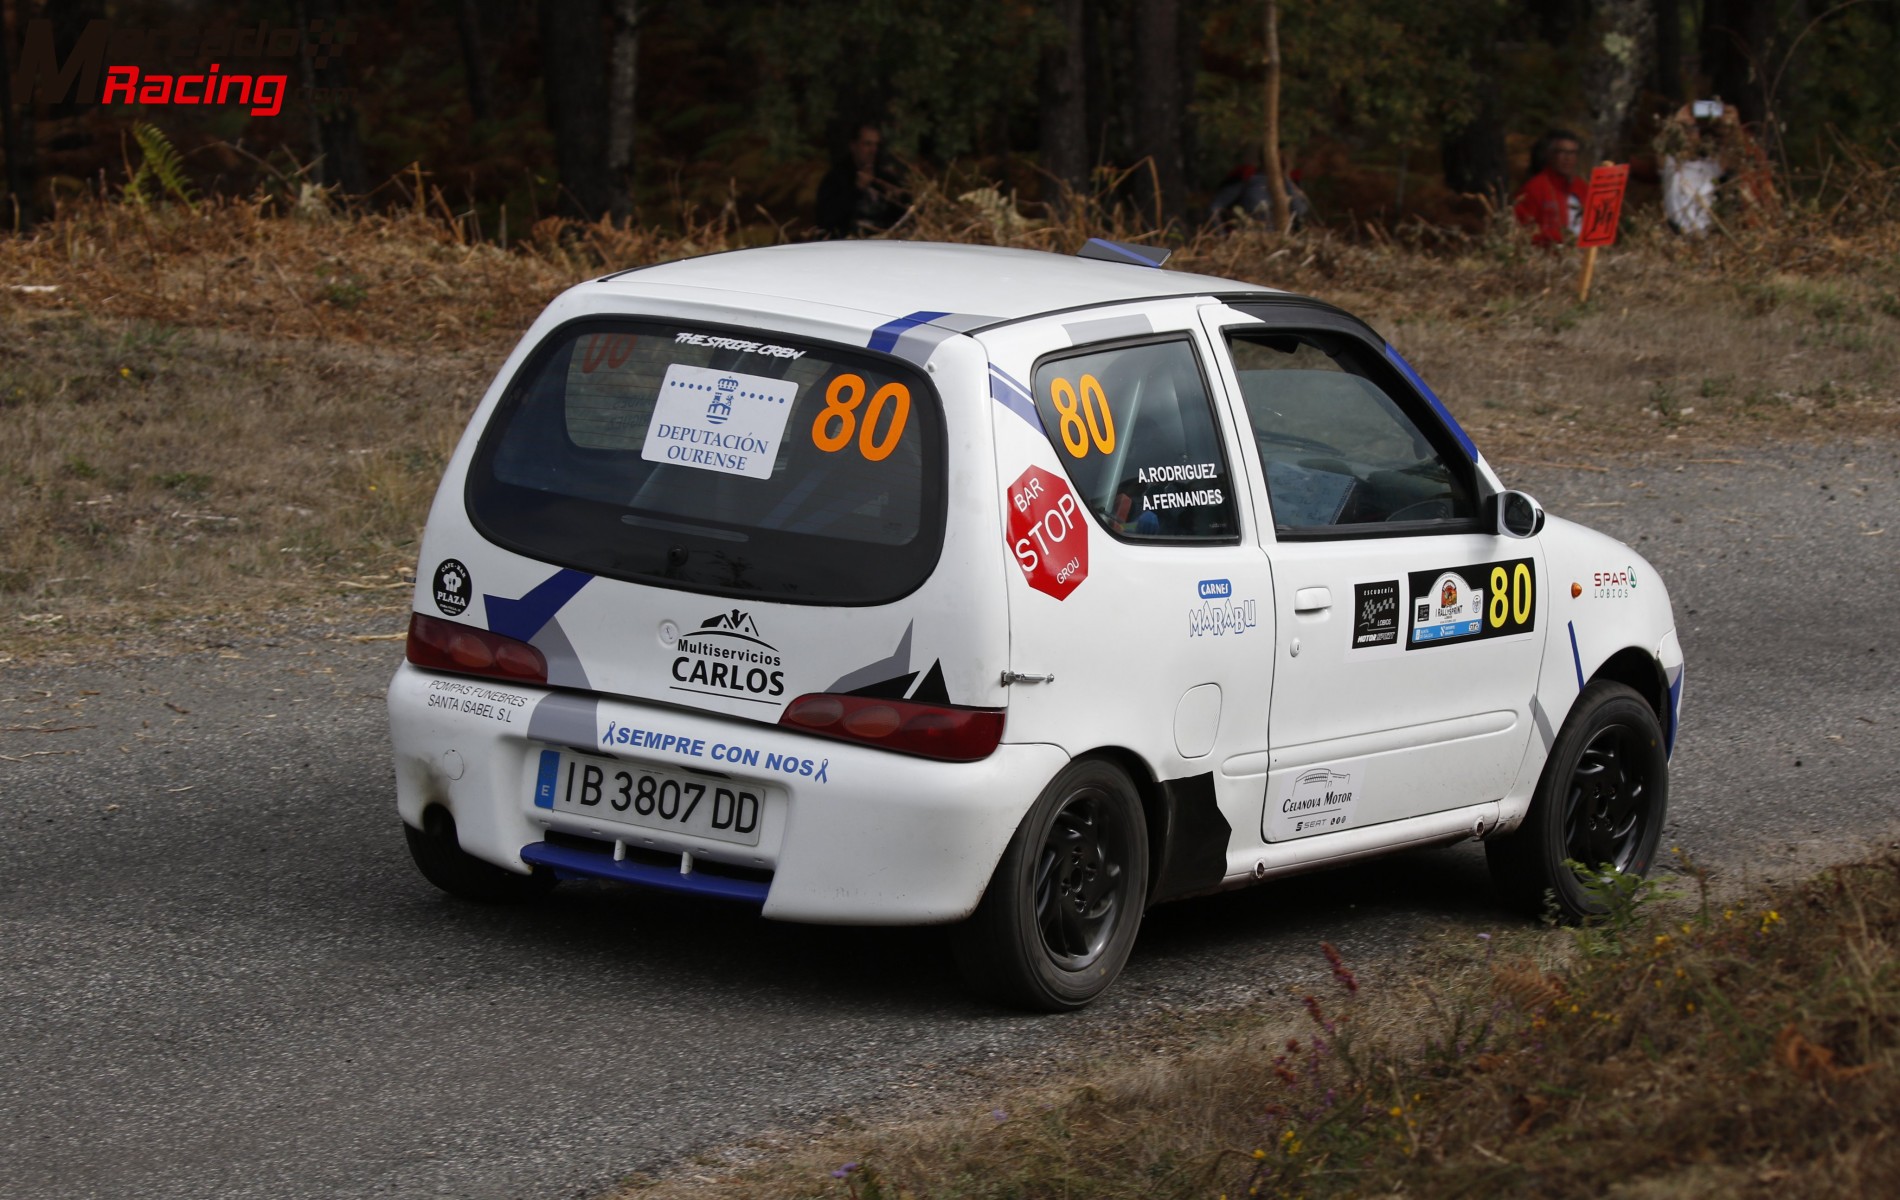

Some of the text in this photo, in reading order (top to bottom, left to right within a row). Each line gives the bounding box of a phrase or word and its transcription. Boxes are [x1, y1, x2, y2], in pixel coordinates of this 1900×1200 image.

[674, 332, 807, 360] THE STRIPE CREW
[811, 373, 912, 462] 80
[1050, 374, 1116, 458] 80
[657, 423, 769, 455] DEPUTACIÓN
[667, 445, 748, 471] OURENSE
[1138, 463, 1217, 483] A.RODRIGUEZ
[1014, 478, 1044, 513] BAR
[1142, 489, 1223, 511] A.FERNANDES
[1015, 494, 1075, 572] STOP
[1056, 557, 1080, 584] GROU
[1594, 572, 1628, 587] SPAR
[437, 591, 467, 607] PLAZA
[1201, 583, 1229, 596] CARNES
[1490, 563, 1532, 628] 80
[1594, 589, 1629, 599] LOBIOS
[1189, 598, 1257, 638] MARABU
[677, 638, 781, 667] Multiservicios
[672, 656, 785, 697] CARLOS
[428, 680, 529, 707] POMPAS FUNEBRES
[428, 694, 459, 711] SANTA
[460, 700, 494, 719] ISABEL
[616, 727, 815, 777] SEMPRE CON NOS
[540, 785, 551, 797] E
[565, 762, 760, 834] IB 3807 DD
